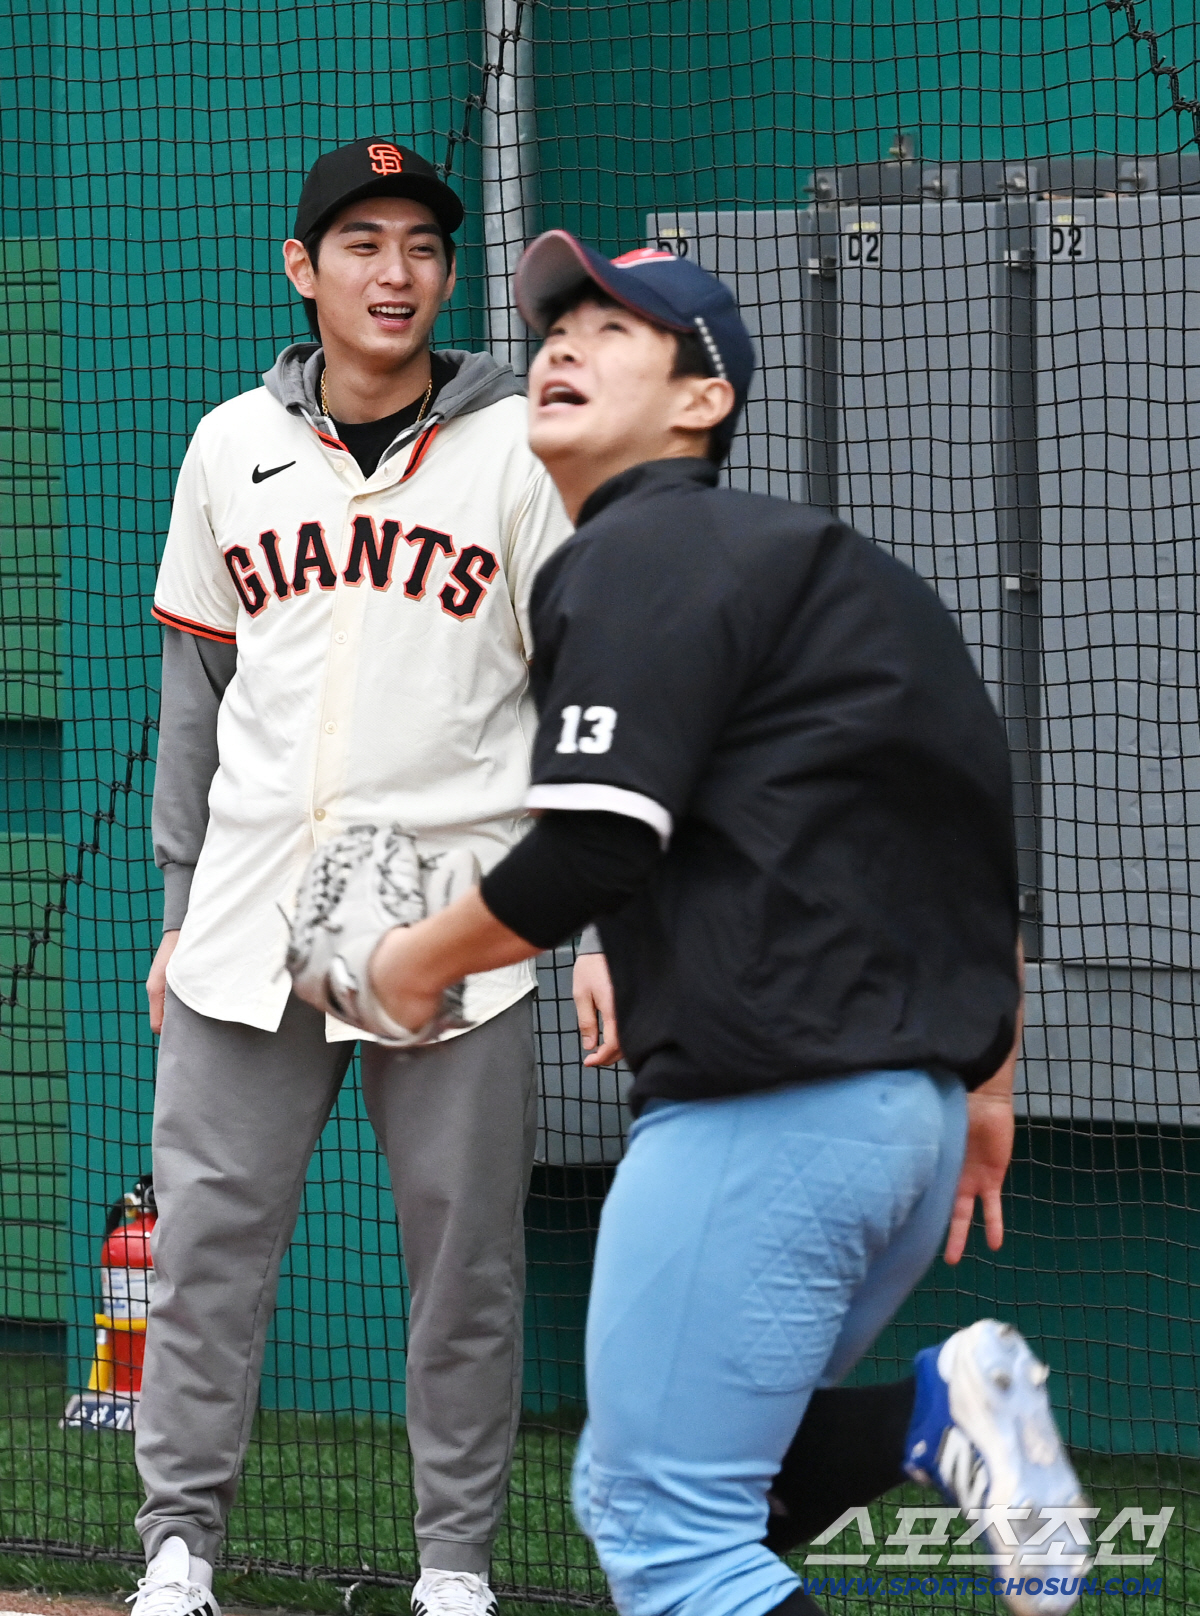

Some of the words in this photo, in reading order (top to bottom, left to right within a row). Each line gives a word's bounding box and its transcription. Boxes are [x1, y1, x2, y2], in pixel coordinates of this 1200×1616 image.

[367, 143, 404, 176] SF
[849, 233, 879, 262] D2
[1050, 227, 1082, 256] D2
[223, 514, 499, 621] GIANTS
[555, 704, 618, 754] 13
